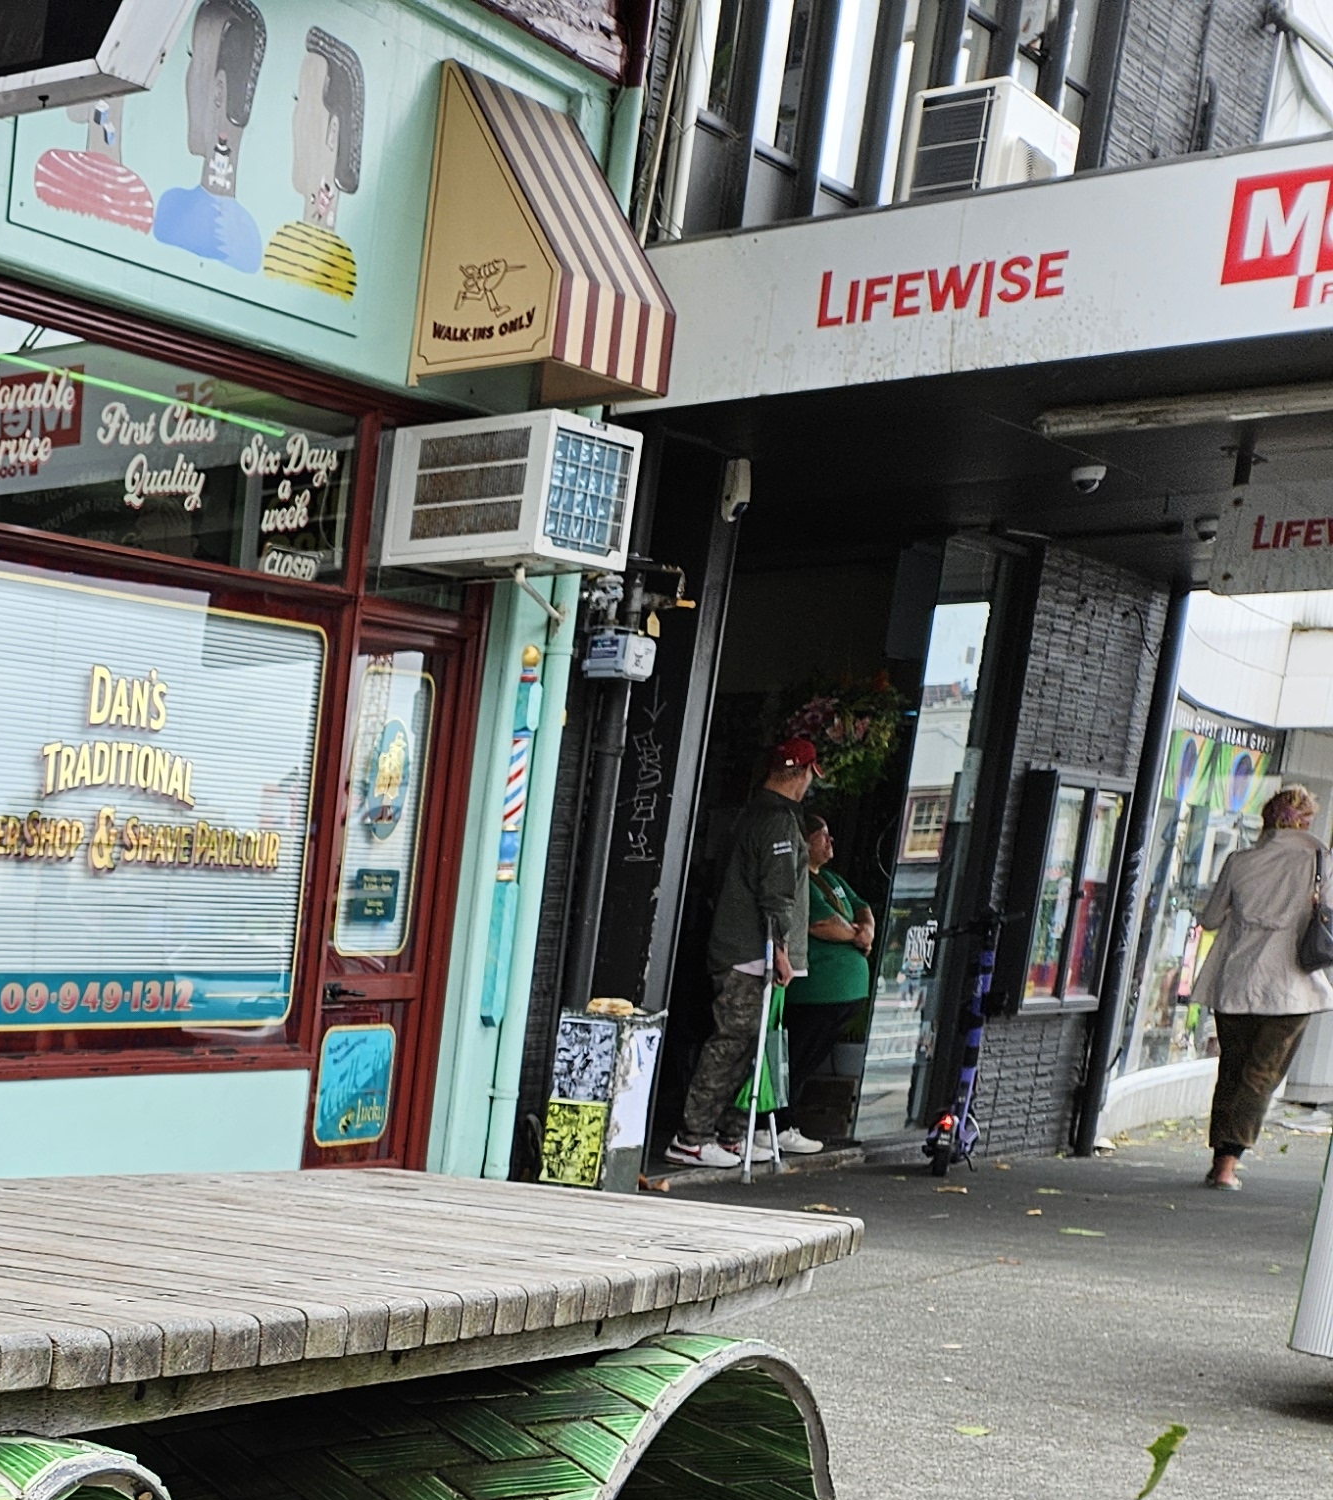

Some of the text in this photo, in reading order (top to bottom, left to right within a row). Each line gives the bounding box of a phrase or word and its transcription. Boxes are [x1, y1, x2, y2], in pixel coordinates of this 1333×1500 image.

[817, 250, 1070, 328] LIFEWISE
[498, 306, 536, 337] ONLY
[97, 402, 217, 445] First Class
[123, 453, 206, 511] Quality
[240, 433, 338, 487] Six Days
[261, 489, 311, 533] week
[278, 479, 292, 500] a
[1252, 514, 1333, 550] LIFE
[264, 551, 316, 581] CLOSED
[88, 664, 169, 731] DAN'S
[42, 741, 195, 808] TRADITIONAL
[23, 811, 85, 860] SHOP
[90, 806, 118, 871] &
[123, 817, 194, 865] SHAVE
[194, 820, 281, 869] PARLOUR
